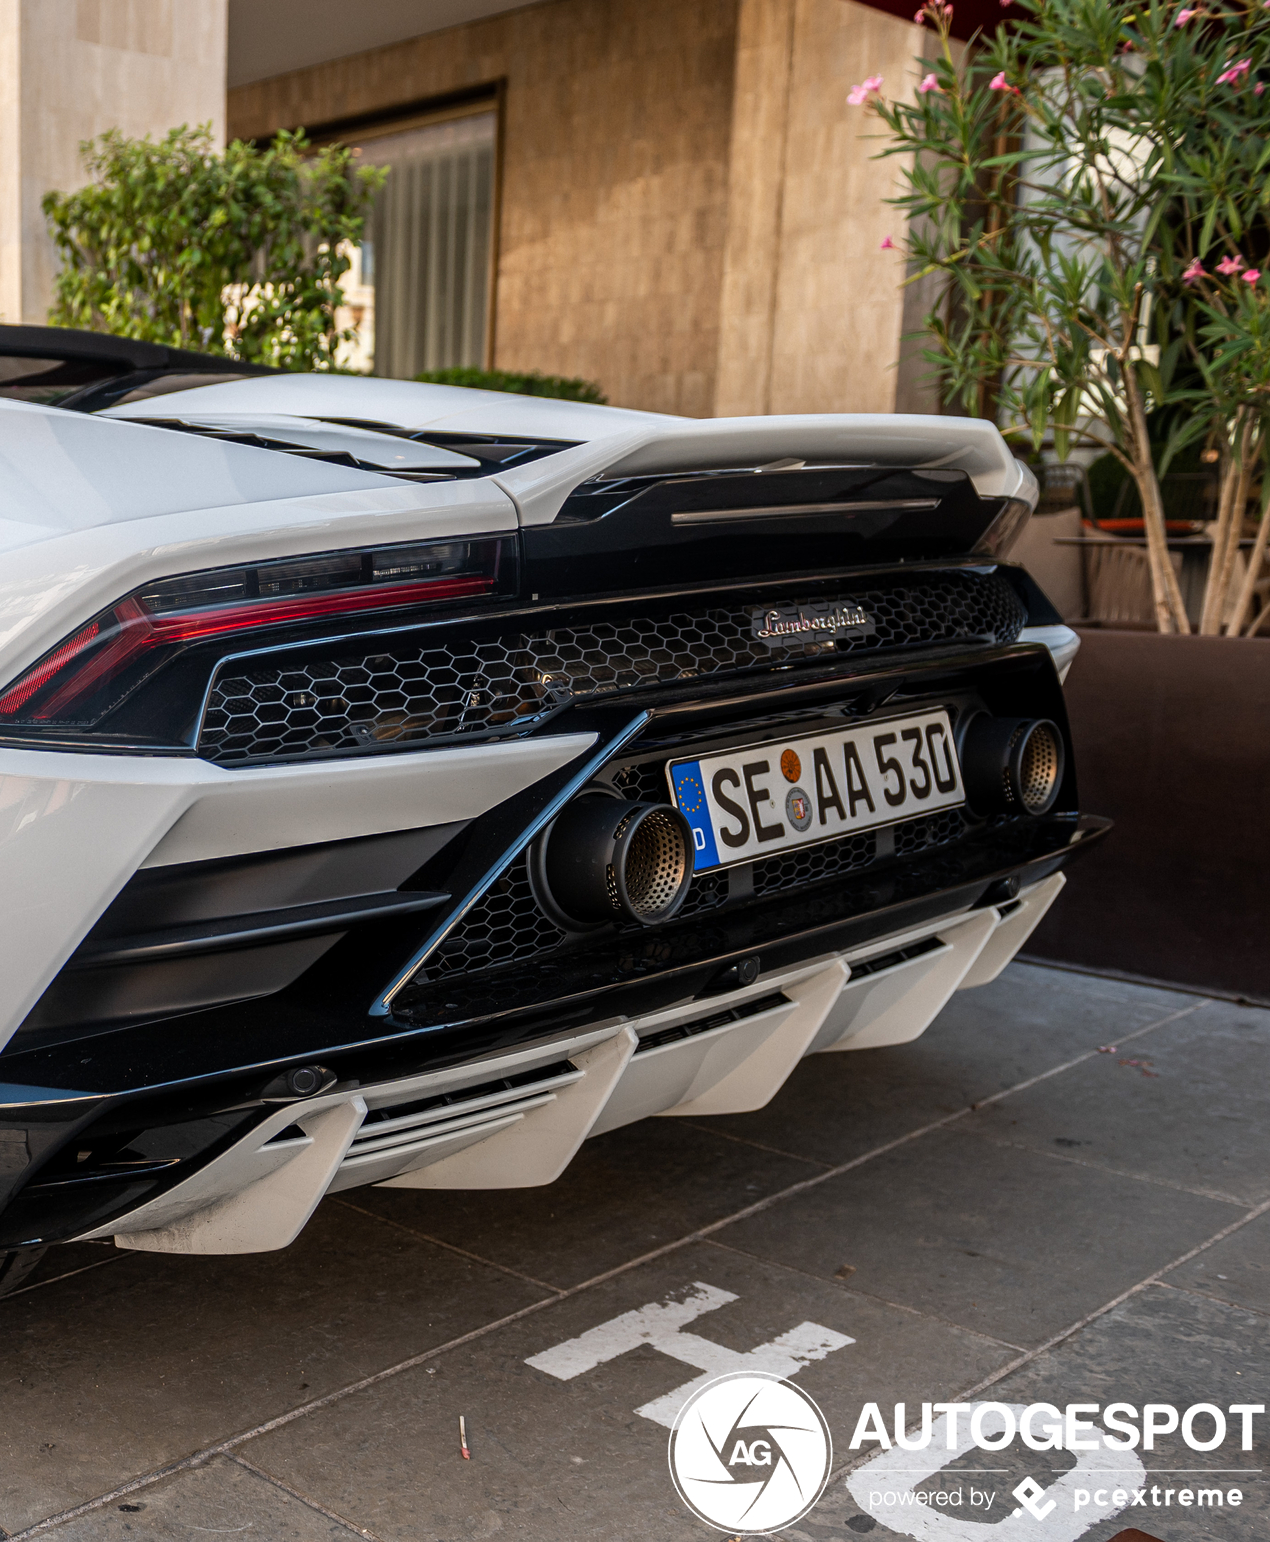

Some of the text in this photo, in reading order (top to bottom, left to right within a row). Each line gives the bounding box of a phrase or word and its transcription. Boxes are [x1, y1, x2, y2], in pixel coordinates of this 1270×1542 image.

[757, 605, 866, 637] Lamborghini
[711, 760, 785, 848] SE
[813, 741, 876, 826] AA
[873, 722, 957, 807] 530
